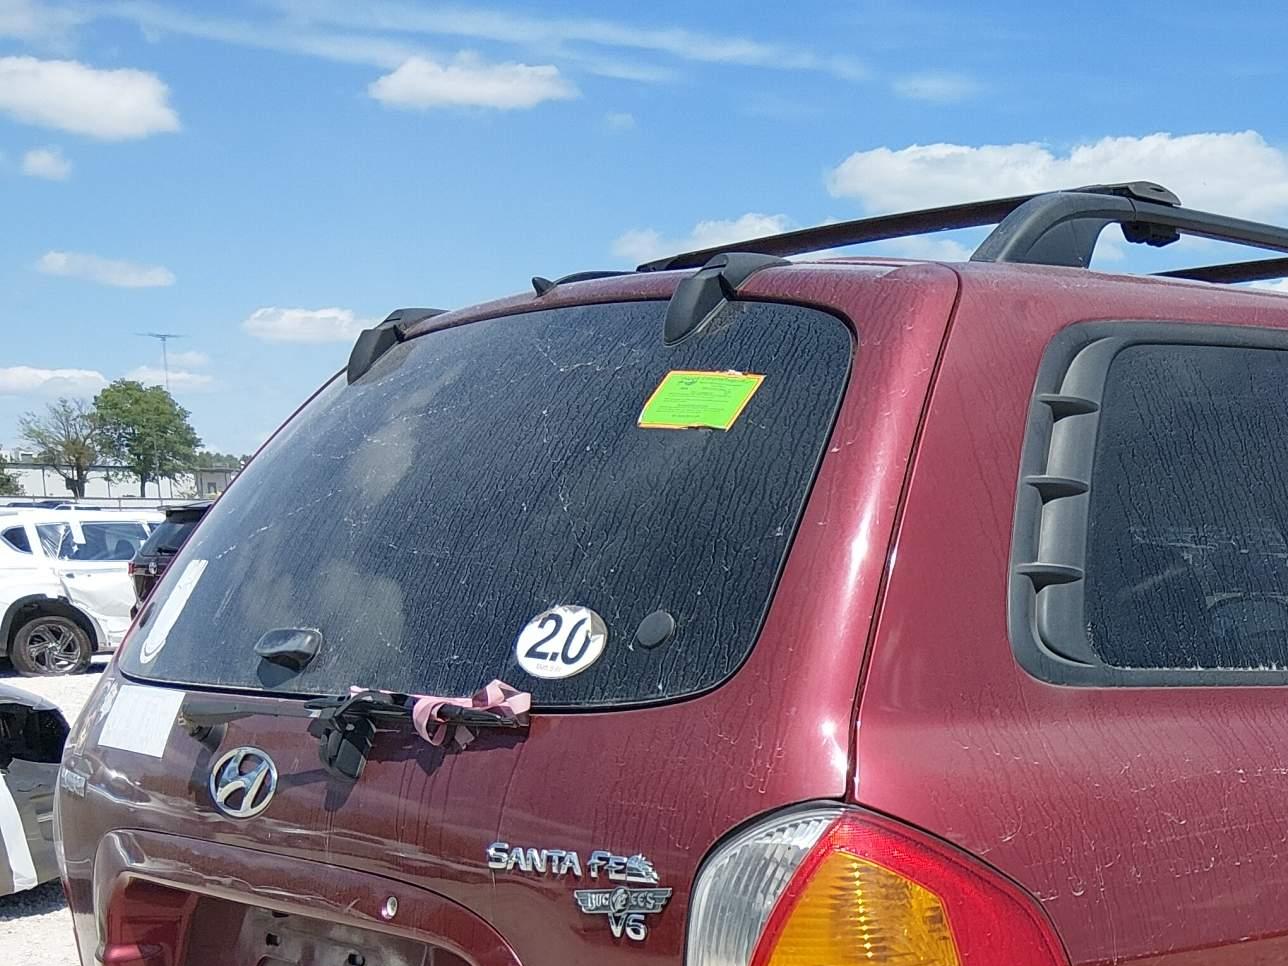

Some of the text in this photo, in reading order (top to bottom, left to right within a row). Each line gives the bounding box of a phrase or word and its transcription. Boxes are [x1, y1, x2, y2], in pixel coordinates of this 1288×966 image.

[524, 613, 592, 665] 2.0
[487, 841, 627, 880] SANTA FE
[608, 913, 648, 940] V6
